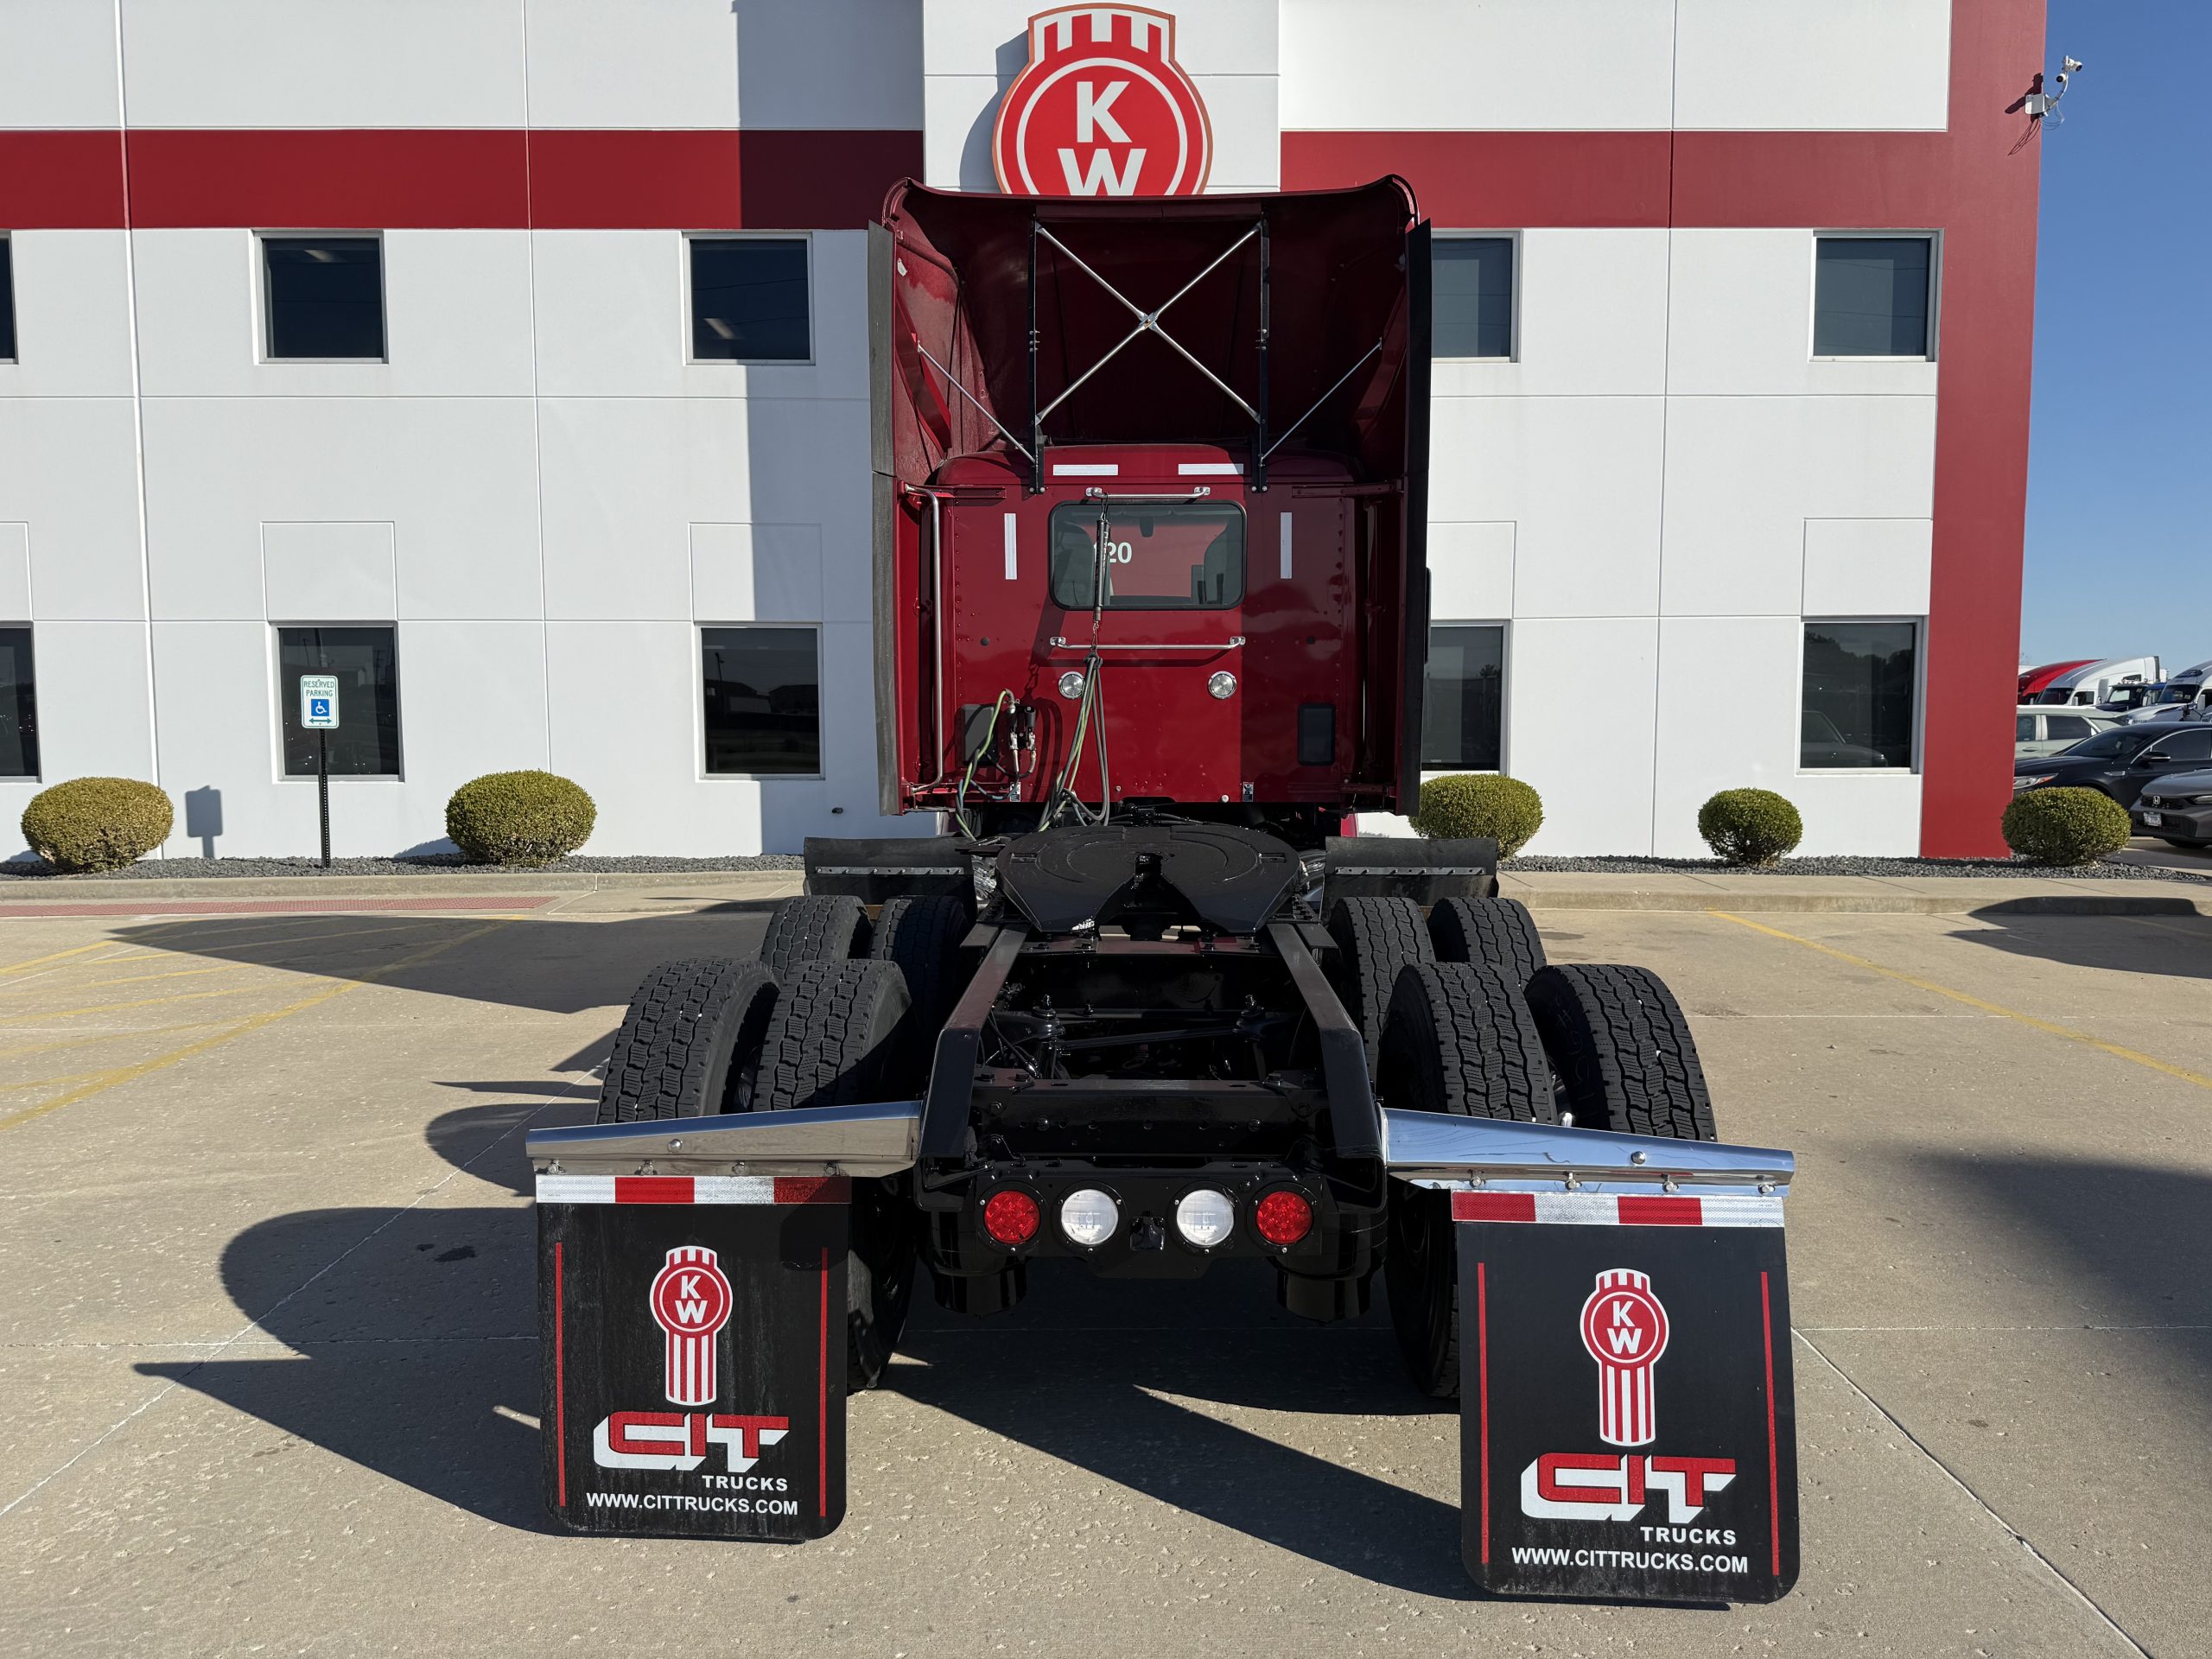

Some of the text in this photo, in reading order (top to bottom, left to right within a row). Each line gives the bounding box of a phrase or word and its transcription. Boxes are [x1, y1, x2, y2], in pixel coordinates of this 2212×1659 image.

[1077, 80, 1133, 143] K
[1058, 148, 1147, 196] W
[680, 1274, 702, 1300] K
[675, 1300, 708, 1325] W
[1612, 1300, 1636, 1327] K
[1606, 1327, 1643, 1355] W
[593, 1411, 790, 1473] CIT
[702, 1475, 789, 1491] TRUCKS
[1520, 1452, 1737, 1524] CIT
[586, 1492, 798, 1516] WWW.CITTRUCKS.COM
[1639, 1526, 1737, 1546] TRUCKS
[1511, 1547, 1749, 1574] WWW.CITTRUCKS.COM
